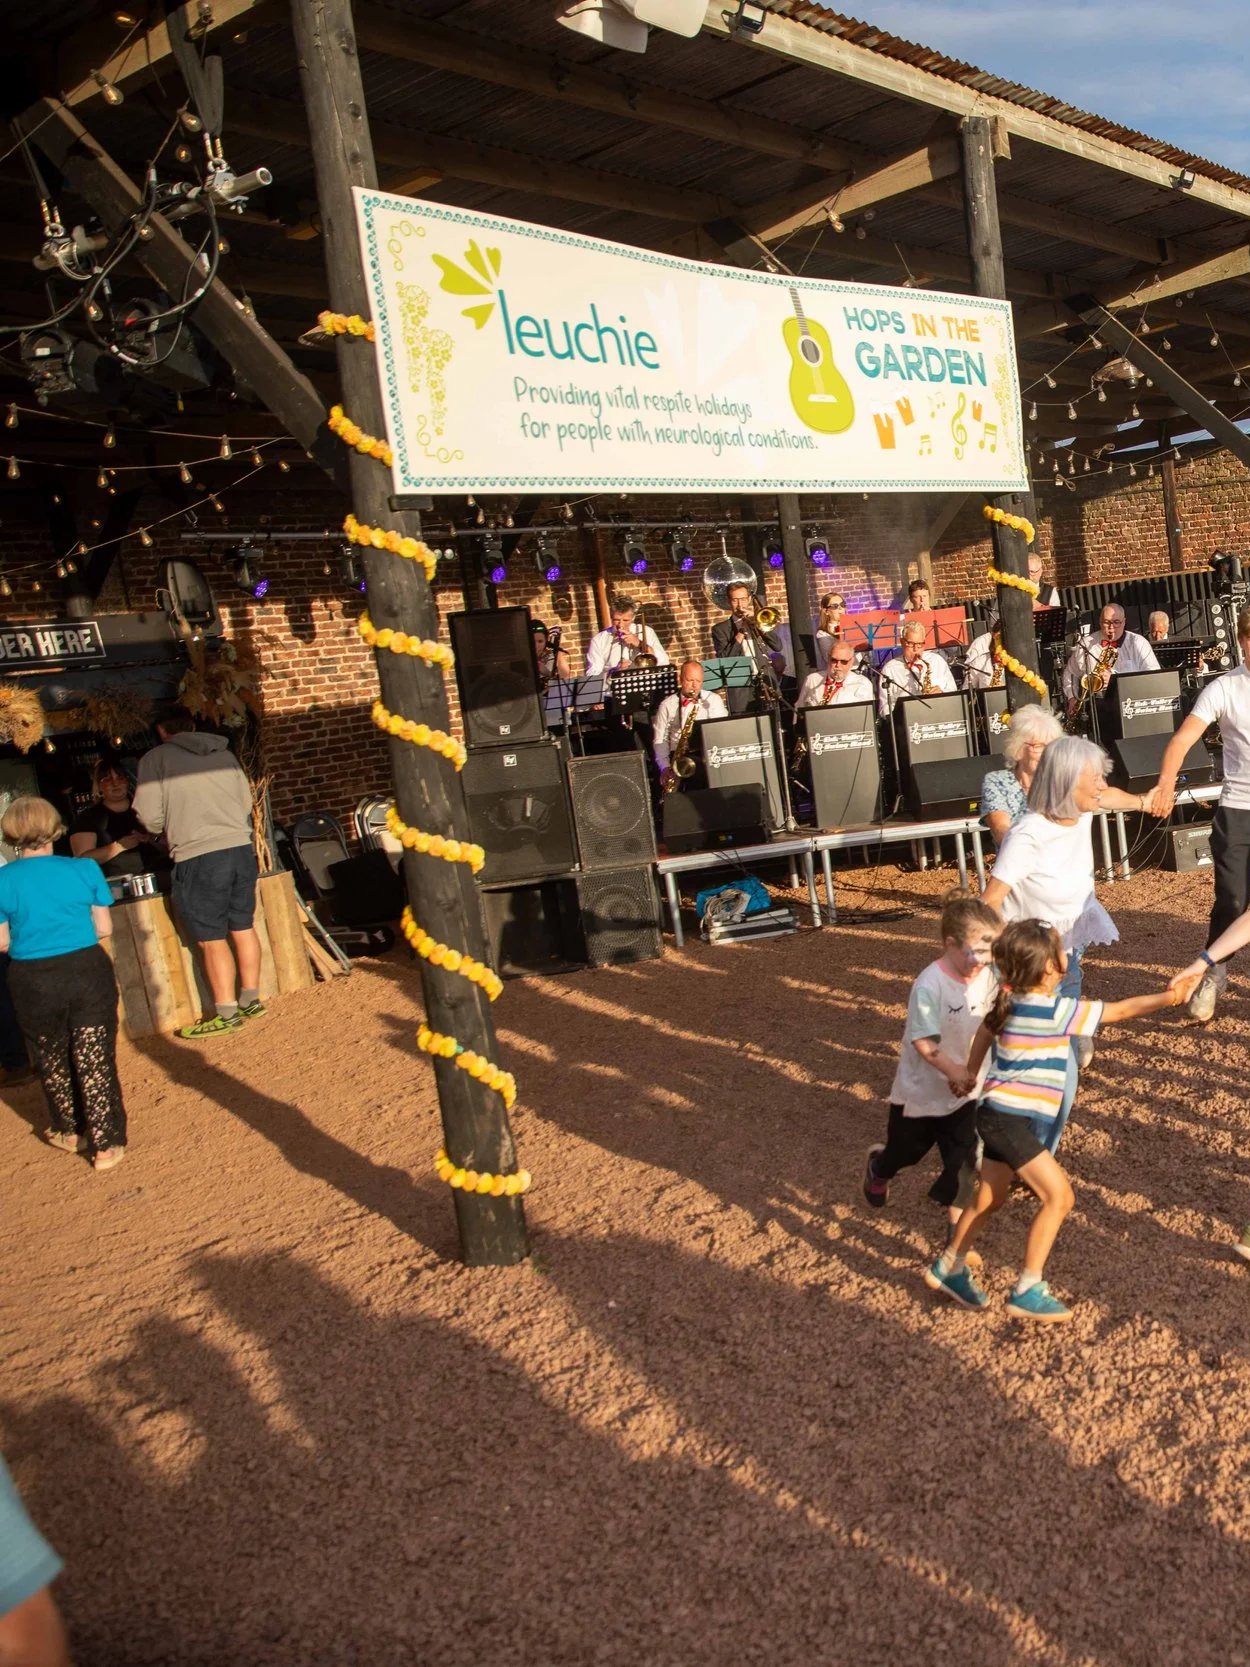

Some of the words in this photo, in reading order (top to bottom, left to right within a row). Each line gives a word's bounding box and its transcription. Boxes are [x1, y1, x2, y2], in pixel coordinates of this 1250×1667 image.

[498, 289, 660, 369] leuchie
[842, 306, 906, 334] HOPS
[912, 313, 938, 337] IN
[942, 316, 981, 342] THE
[855, 341, 988, 386] GARDEN
[513, 376, 602, 418] Providing
[605, 384, 641, 410] vital
[643, 390, 692, 423] respite
[694, 393, 753, 424] holidays
[520, 412, 551, 438] for
[556, 418, 612, 452] people
[617, 418, 653, 445] with
[655, 423, 745, 456] neurological
[748, 427, 819, 449] conditions.
[36, 628, 96, 656] HERE
